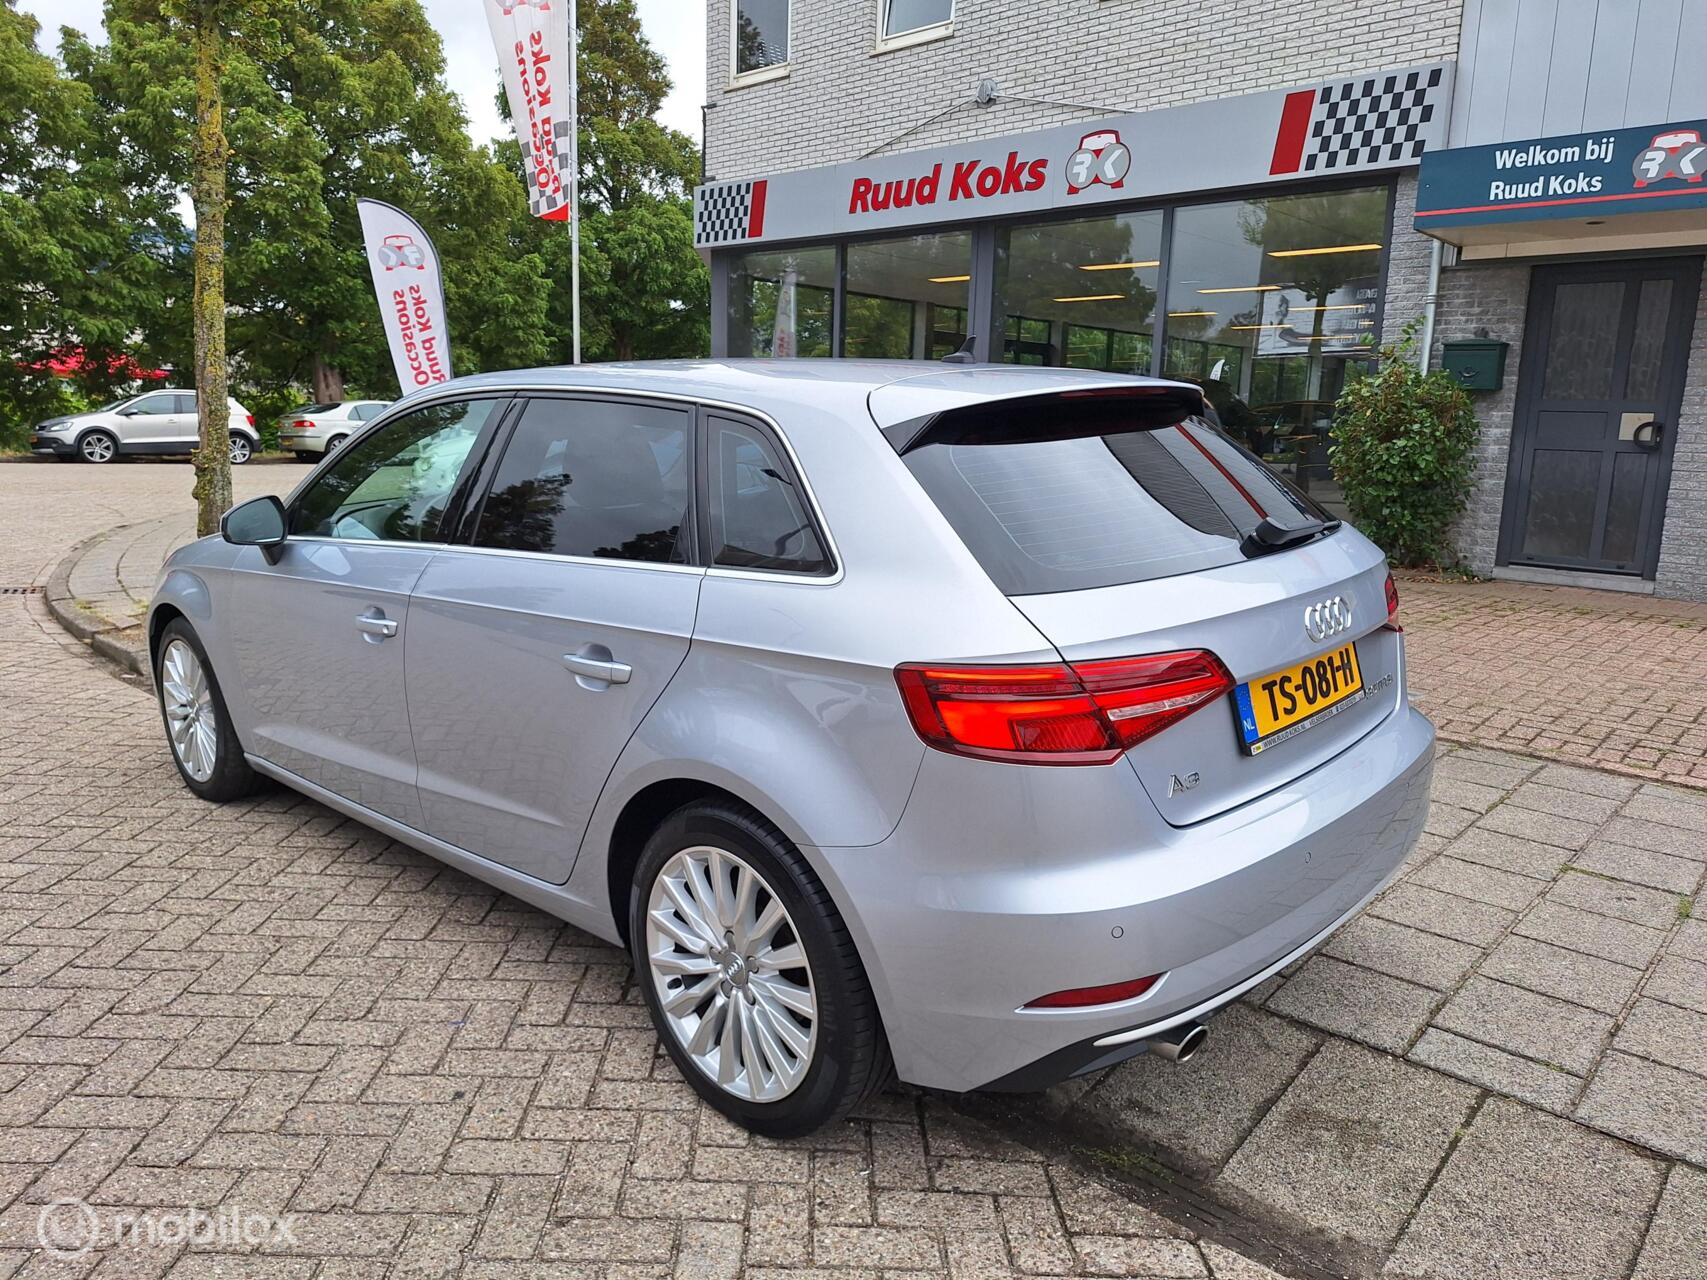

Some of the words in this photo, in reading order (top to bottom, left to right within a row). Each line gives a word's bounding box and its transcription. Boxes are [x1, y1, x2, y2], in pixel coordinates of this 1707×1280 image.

[1495, 145, 1580, 170] Welkom
[1585, 137, 1615, 163] bij
[848, 163, 942, 214] Ruud
[949, 151, 1048, 201] Koks
[1489, 176, 1544, 200] Ruud
[1548, 172, 1602, 197] Koks
[1262, 647, 1355, 722] TS-081-H
[1243, 718, 1255, 732] NL
[1168, 771, 1200, 799] A3
